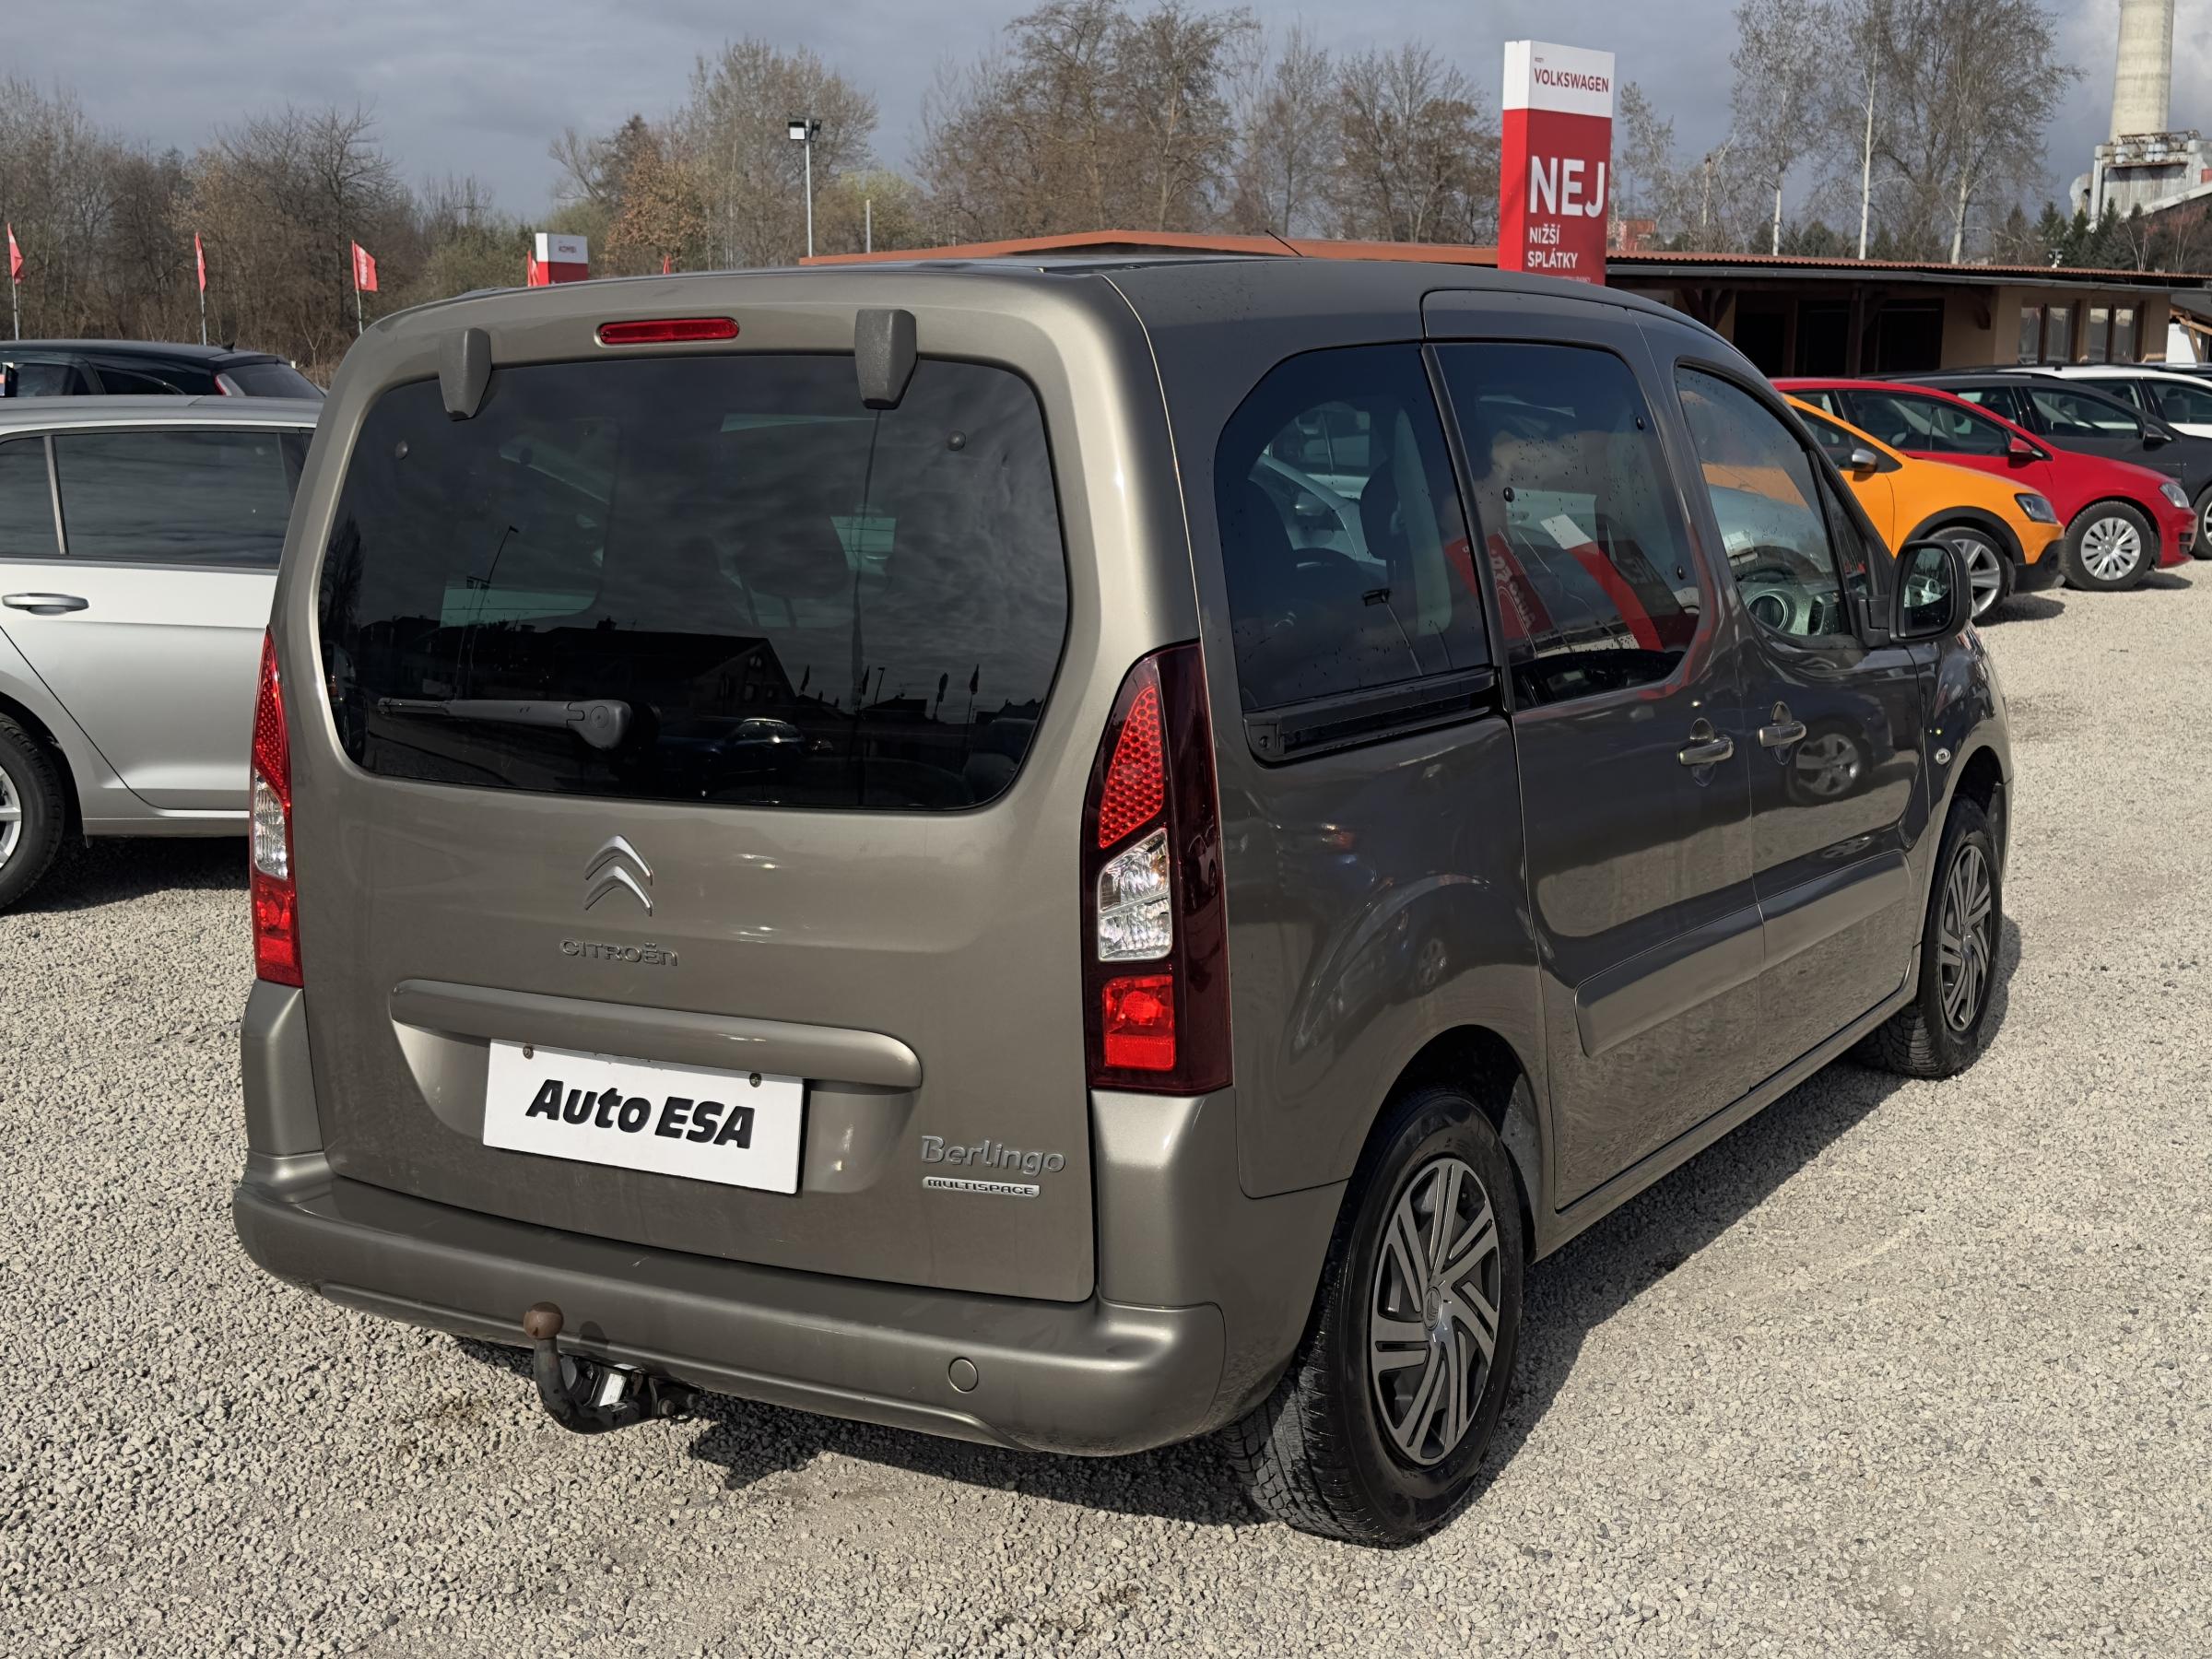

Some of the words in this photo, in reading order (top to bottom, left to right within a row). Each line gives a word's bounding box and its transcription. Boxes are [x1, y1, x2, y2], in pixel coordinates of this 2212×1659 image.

[1534, 67, 1609, 93] VOLKSWAGEN
[1529, 155, 1606, 218] NEJ
[1529, 223, 1561, 245] NIŽŠÍ
[1526, 247, 1579, 270] SPLÁTKY
[559, 938, 678, 966] CITROËN
[524, 1078, 652, 1134] Auto
[654, 1096, 756, 1149] ESA
[921, 1135, 1065, 1178] Berlingo
[927, 1179, 1034, 1195] MULTISPACE
